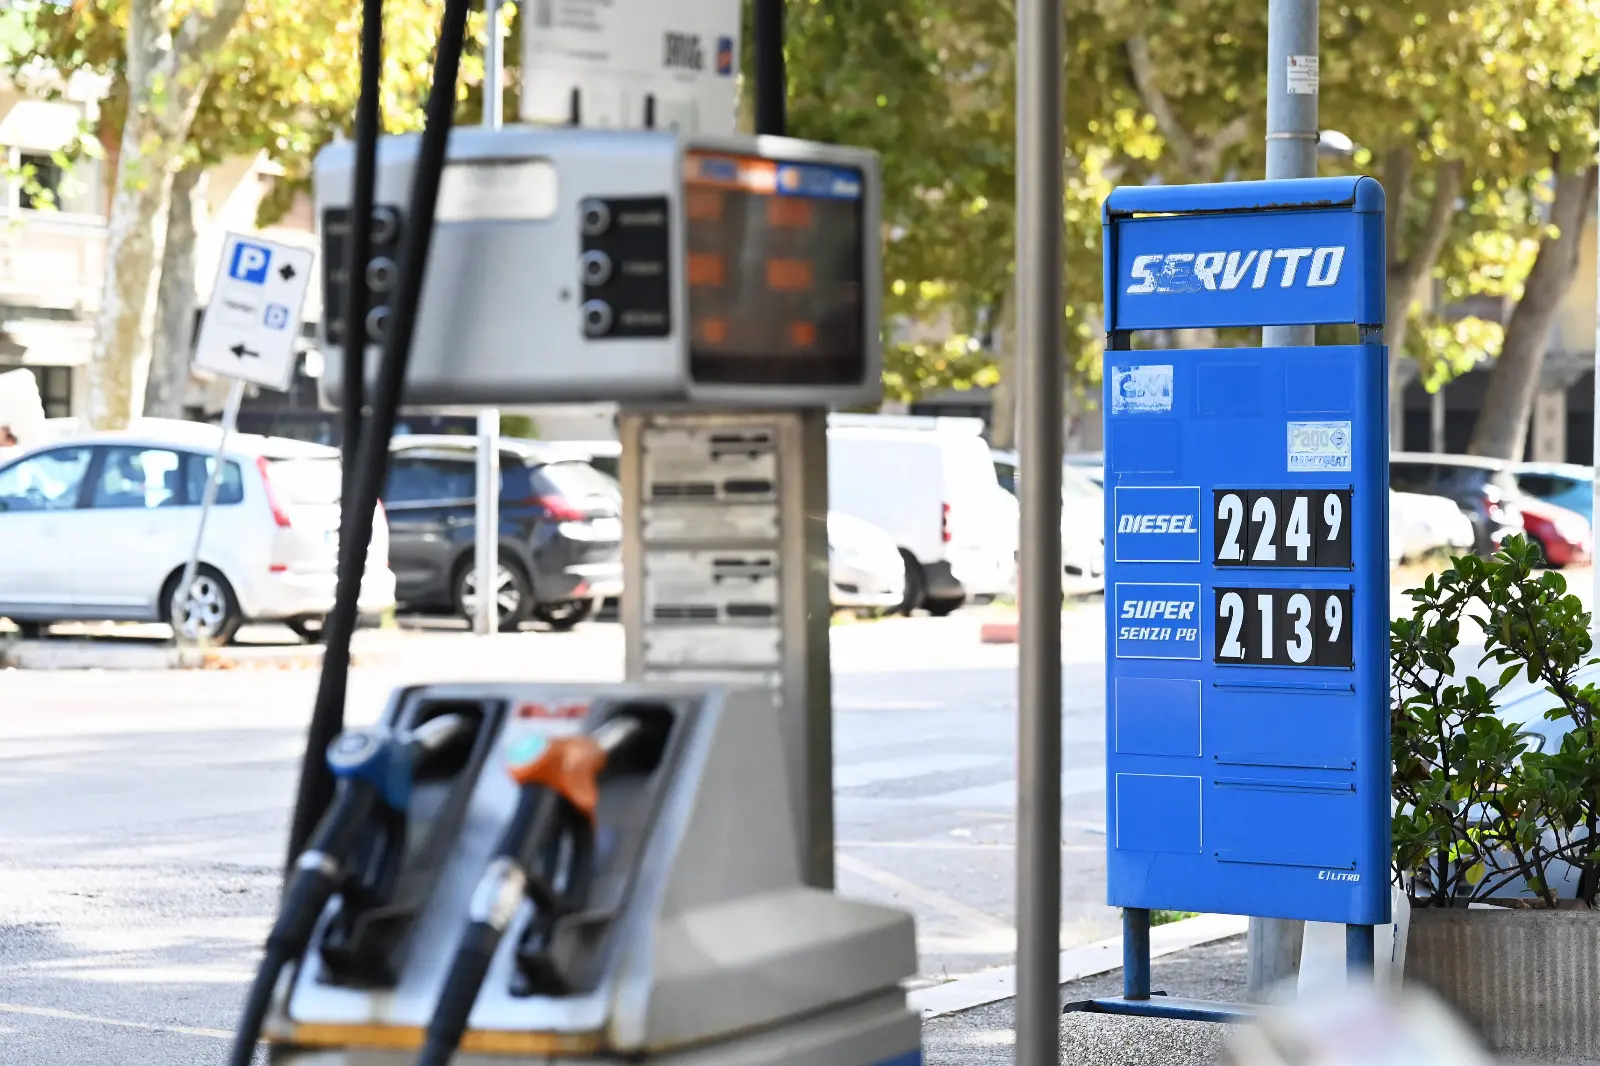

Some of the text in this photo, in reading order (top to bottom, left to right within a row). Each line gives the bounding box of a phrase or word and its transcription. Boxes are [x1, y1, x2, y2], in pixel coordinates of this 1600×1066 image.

[236, 245, 267, 279] P
[1126, 246, 1347, 294] SERVITO
[1117, 514, 1198, 534] DIESEL
[1120, 600, 1195, 620] SUPER
[1118, 626, 1198, 642] SENZA PB
